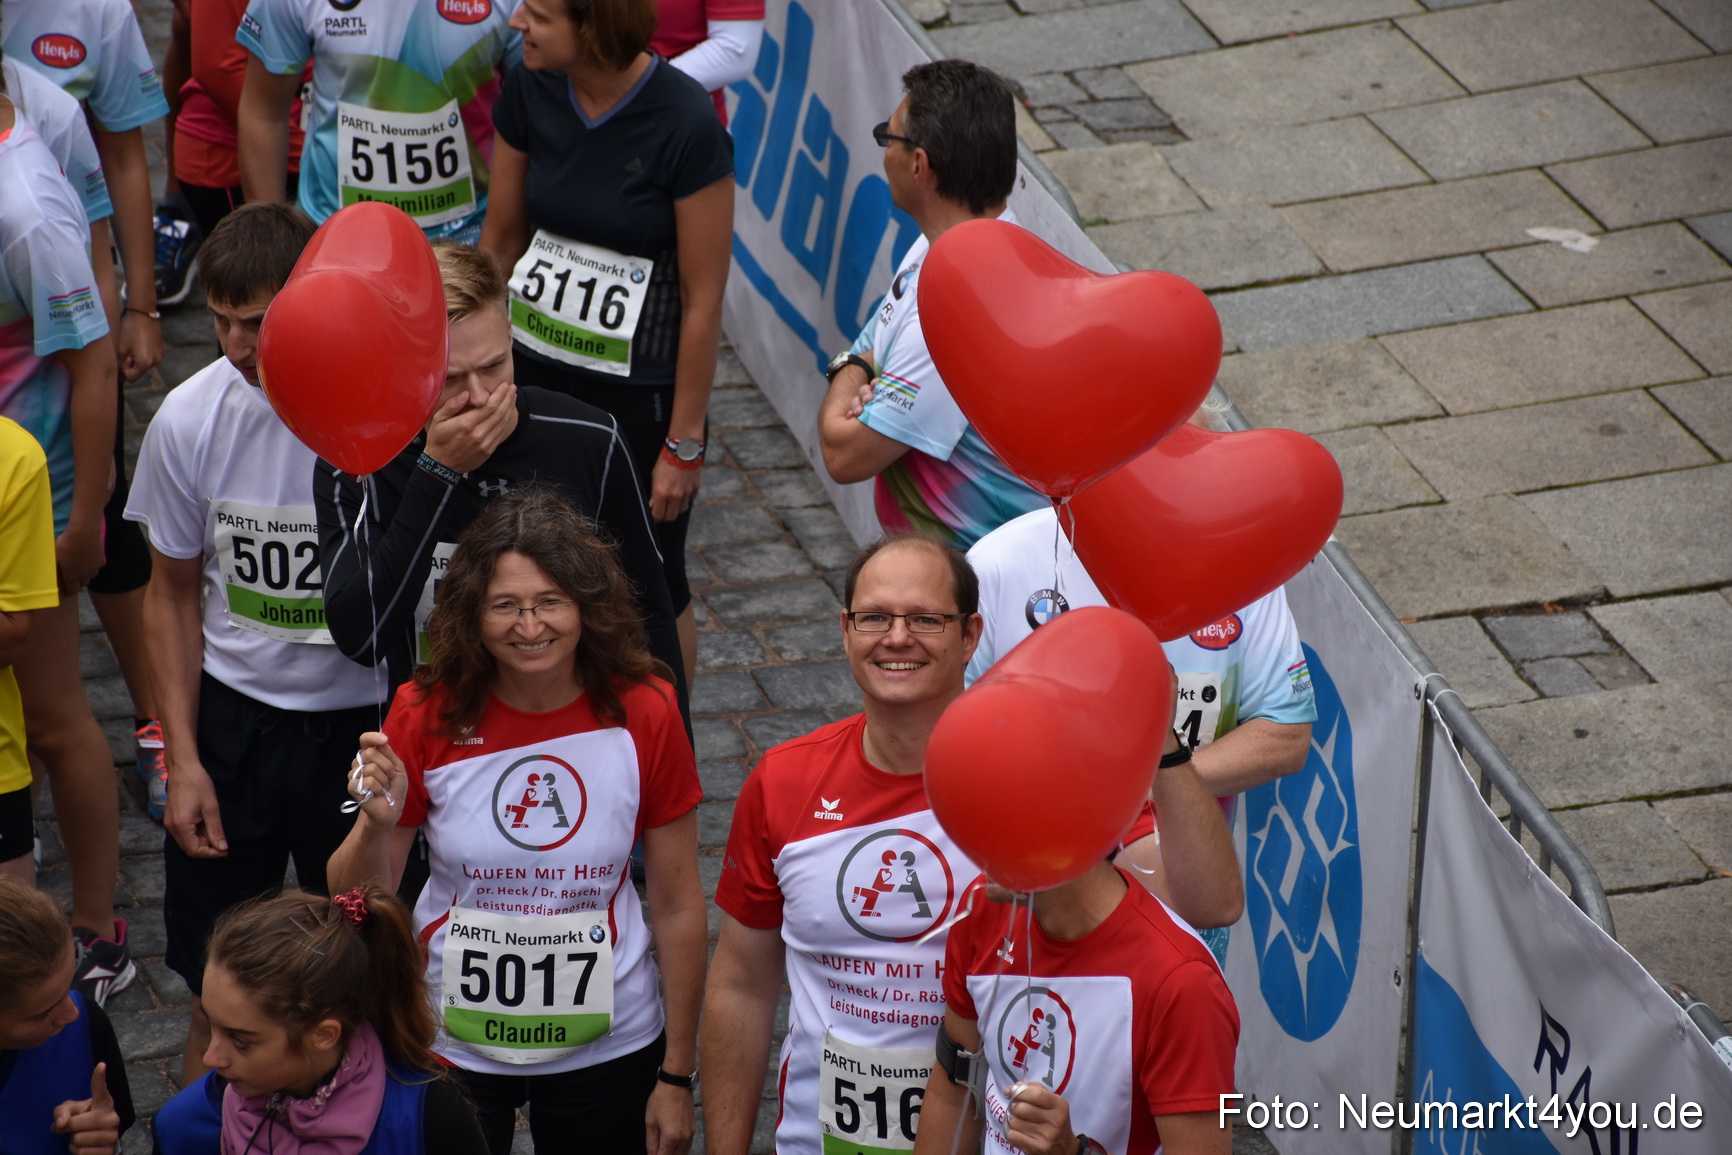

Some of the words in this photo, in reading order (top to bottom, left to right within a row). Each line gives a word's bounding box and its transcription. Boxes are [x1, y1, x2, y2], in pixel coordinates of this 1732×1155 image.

[325, 17, 367, 29] PARTL
[325, 28, 368, 37] Neumarkt
[39, 40, 81, 60] Hervis
[341, 114, 378, 134] PARTL
[381, 123, 445, 137] Neumarkt
[351, 136, 459, 185] 5156
[358, 191, 455, 213] Mimilian
[533, 238, 564, 258] PARTL
[567, 249, 625, 278] Neumarkt
[521, 258, 630, 330] 5116
[527, 313, 606, 355] Christiane
[217, 512, 263, 532] PARTL
[268, 521, 319, 533] Neuma
[231, 535, 323, 591] 502
[814, 810, 843, 821] erima
[476, 887, 495, 895] Dr.
[498, 886, 529, 896] Heck
[541, 888, 557, 899] Dr.
[561, 886, 601, 899] Röschl
[476, 900, 598, 916] Leistungsdiagnostik
[451, 923, 501, 944] PARTL
[505, 931, 584, 945] Neumarkt
[460, 949, 598, 1008] 5017
[827, 978, 845, 992] Dr.
[846, 984, 879, 1000] Heck
[893, 990, 914, 1002] Dr.
[919, 990, 946, 1003] Rös
[830, 995, 945, 1028] Leistungsdiagno
[485, 1019, 567, 1043] Claudia
[823, 1048, 867, 1075] PARTL
[871, 1063, 932, 1078] Neuma
[834, 1077, 926, 1142] 516
